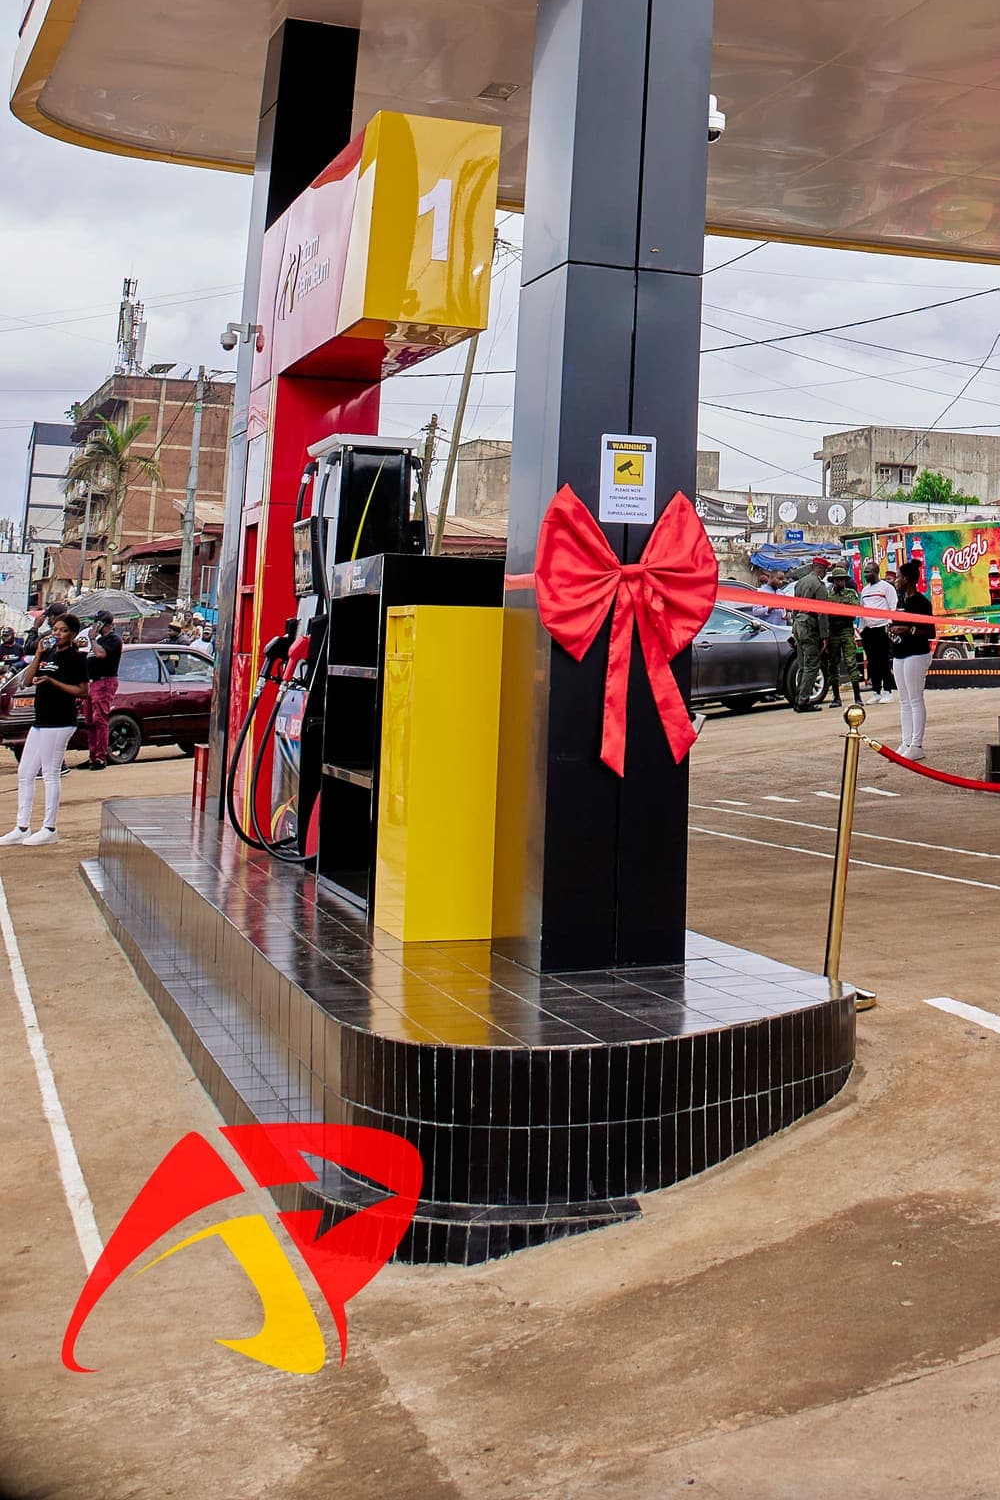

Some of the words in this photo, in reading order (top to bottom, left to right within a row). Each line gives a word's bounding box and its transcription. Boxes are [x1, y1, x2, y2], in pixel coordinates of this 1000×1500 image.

[418, 178, 453, 261] 1
[612, 442, 647, 451] WARNING
[942, 533, 989, 573] Razzl
